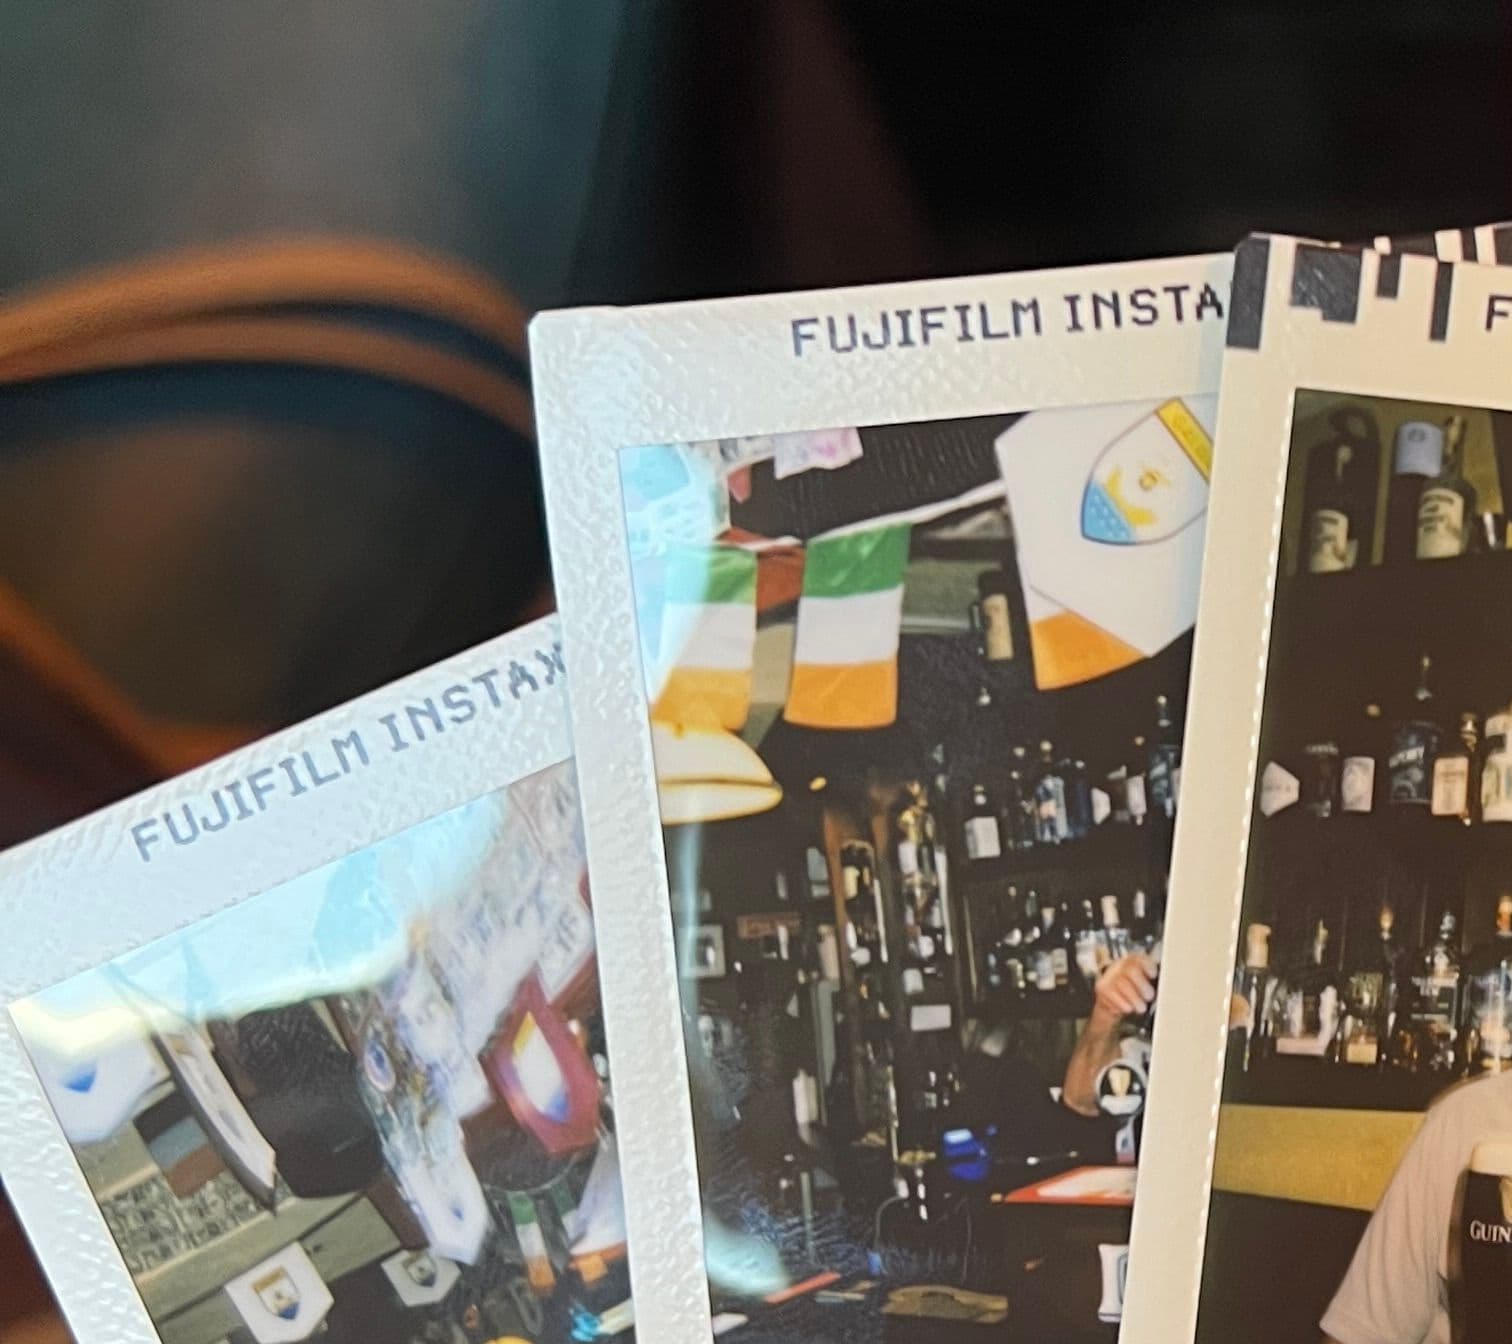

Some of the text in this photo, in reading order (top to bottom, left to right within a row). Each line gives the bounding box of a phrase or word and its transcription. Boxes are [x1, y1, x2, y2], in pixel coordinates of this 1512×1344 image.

[789, 281, 1227, 357] FUJIFILM INSTA
[130, 640, 569, 863] FUJIFILM INSTAX
